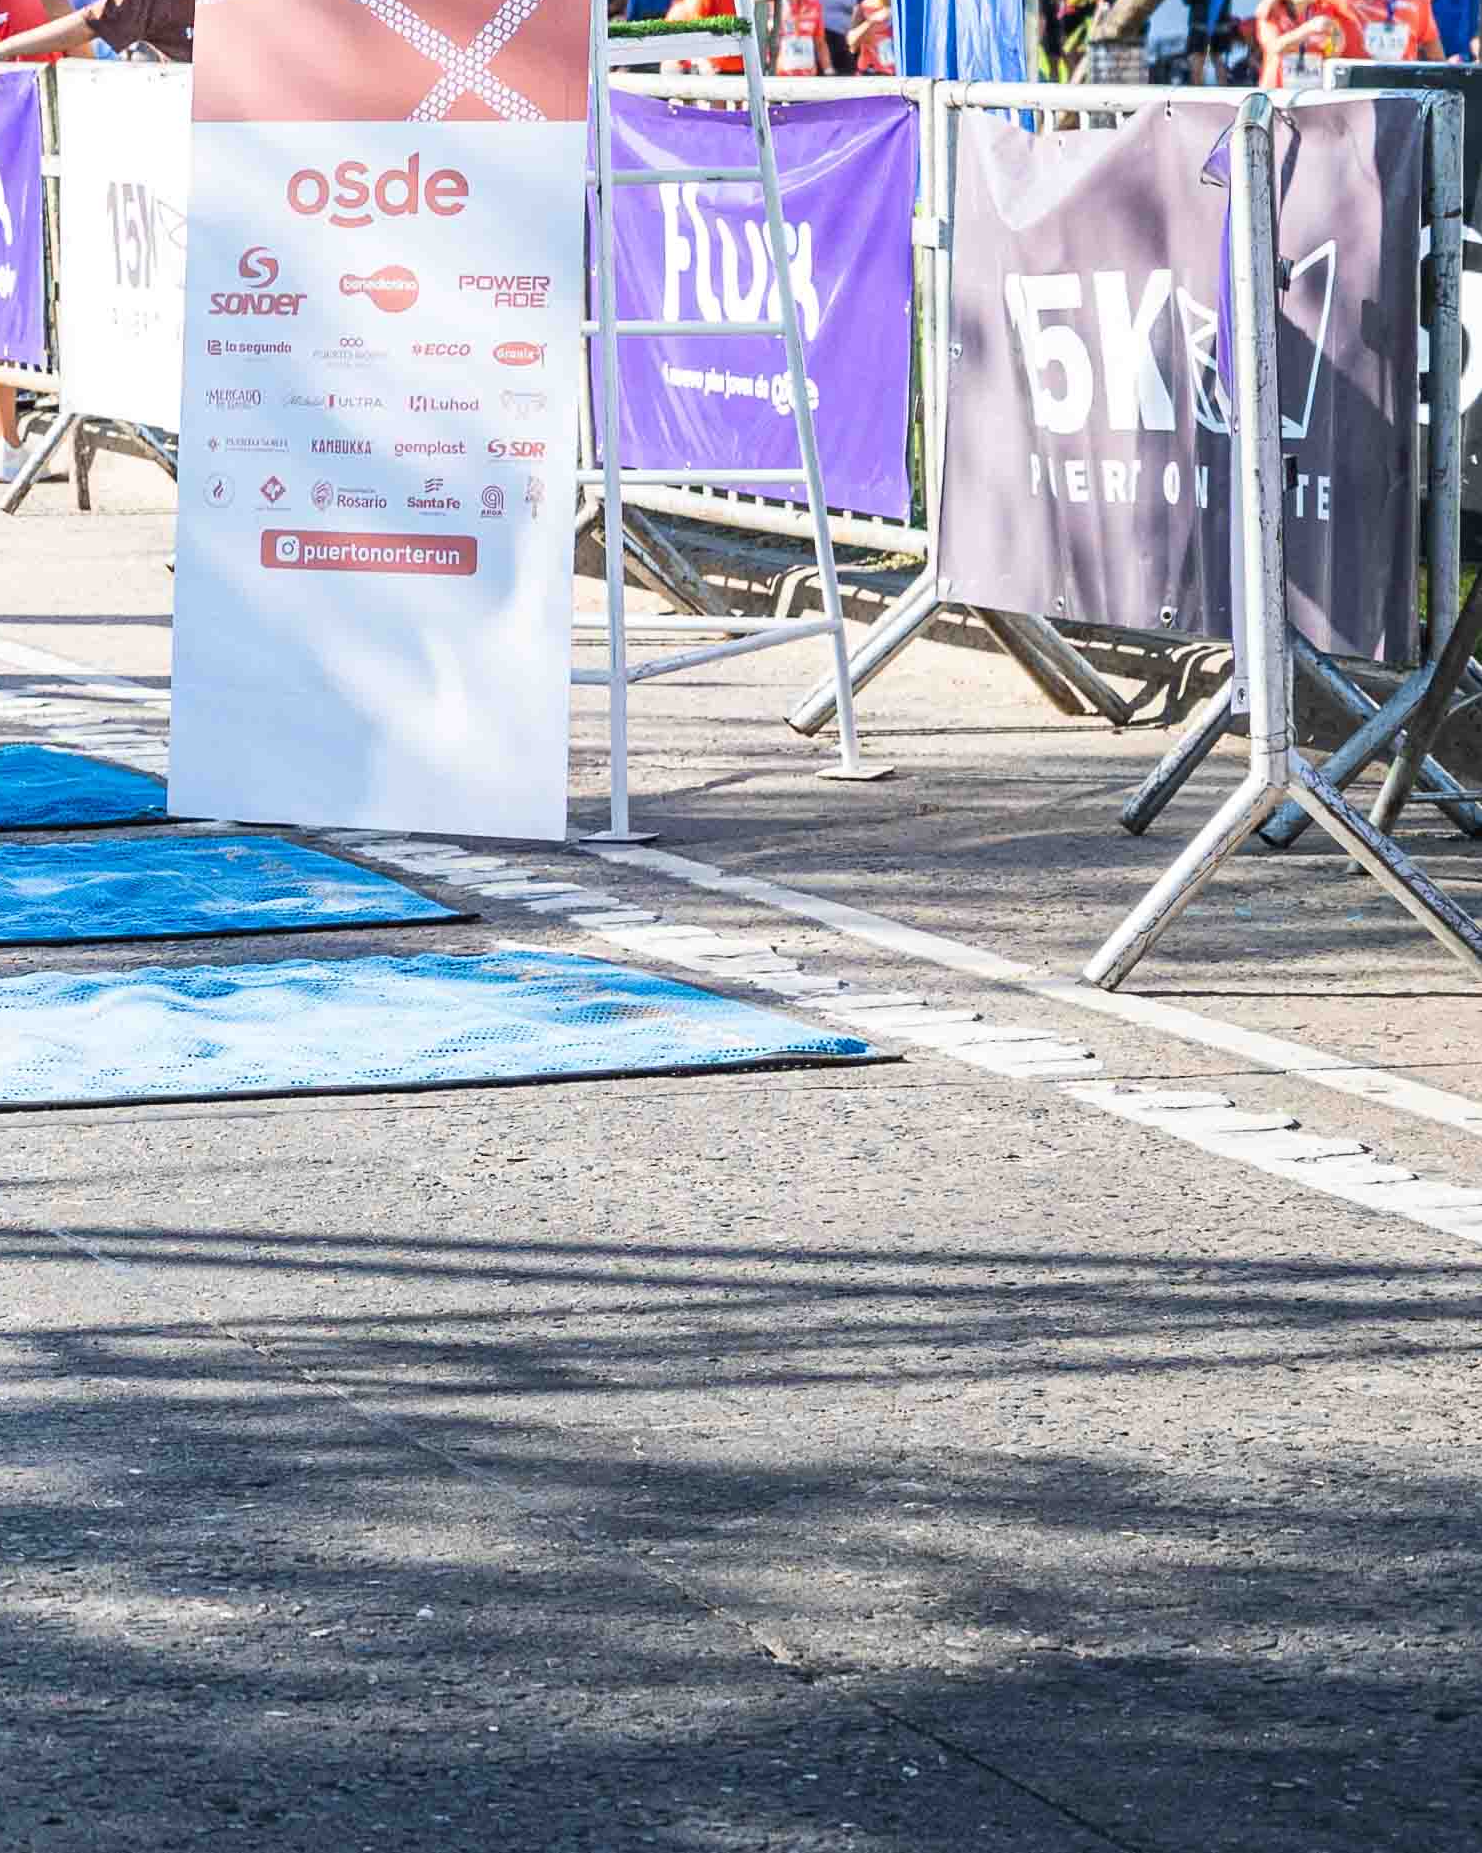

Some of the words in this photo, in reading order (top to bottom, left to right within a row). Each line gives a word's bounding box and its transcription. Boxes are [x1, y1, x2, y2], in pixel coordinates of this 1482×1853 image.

[286, 150, 469, 229] osde
[106, 179, 159, 289] 15K
[459, 275, 551, 291] POWER
[494, 292, 547, 308] ADE
[225, 339, 237, 353] la
[238, 340, 293, 356] segunda
[424, 343, 472, 357] ECCO
[338, 398, 384, 409] ULTRA
[311, 438, 372, 455] KAMBUKKA
[393, 439, 467, 457] gemplast
[509, 441, 546, 458] SDR
[336, 494, 388, 509] Rosario
[407, 496, 444, 509] Santa
[446, 497, 461, 509] Fe
[304, 542, 461, 565] puertonorterun
